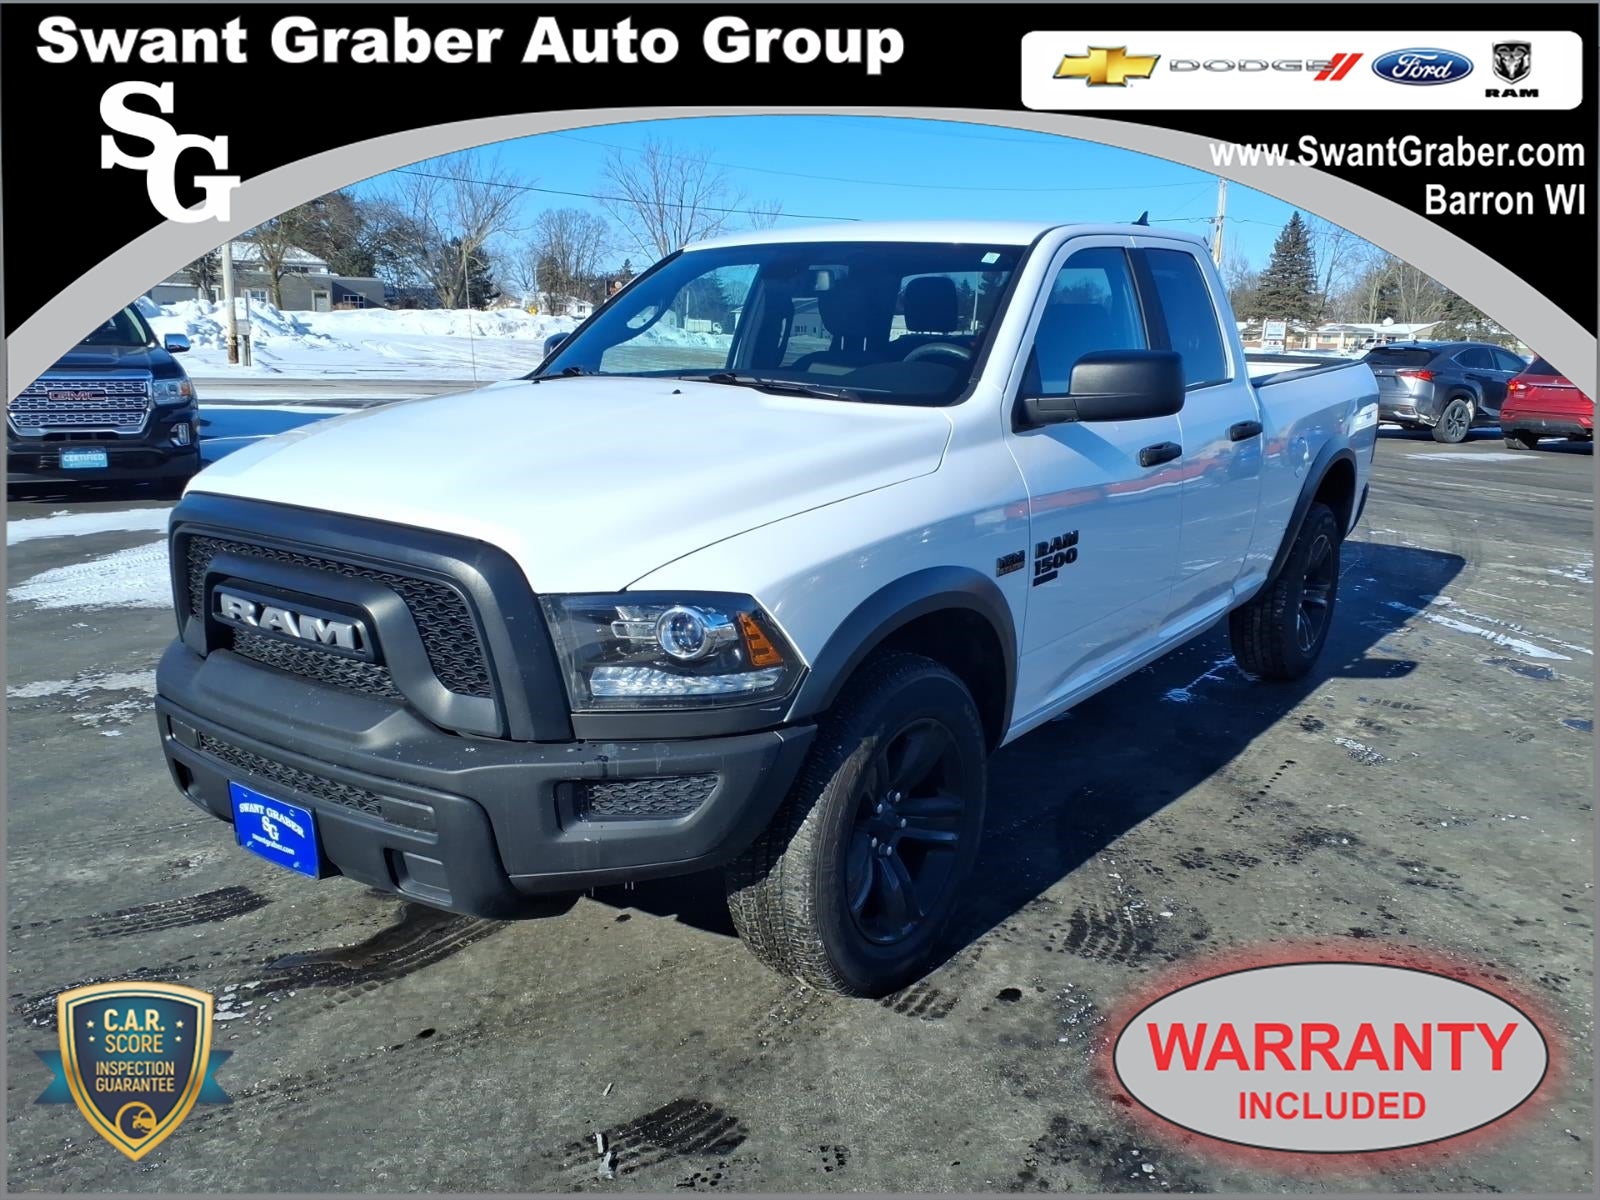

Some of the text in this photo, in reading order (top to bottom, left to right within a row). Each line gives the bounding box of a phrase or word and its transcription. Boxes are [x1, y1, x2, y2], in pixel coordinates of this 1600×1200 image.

[49, 391, 106, 401] GMC
[1035, 530, 1079, 559] RAM
[1034, 548, 1078, 576] 1500
[221, 593, 355, 650] RAM
[238, 803, 305, 838] SWANT GRABER
